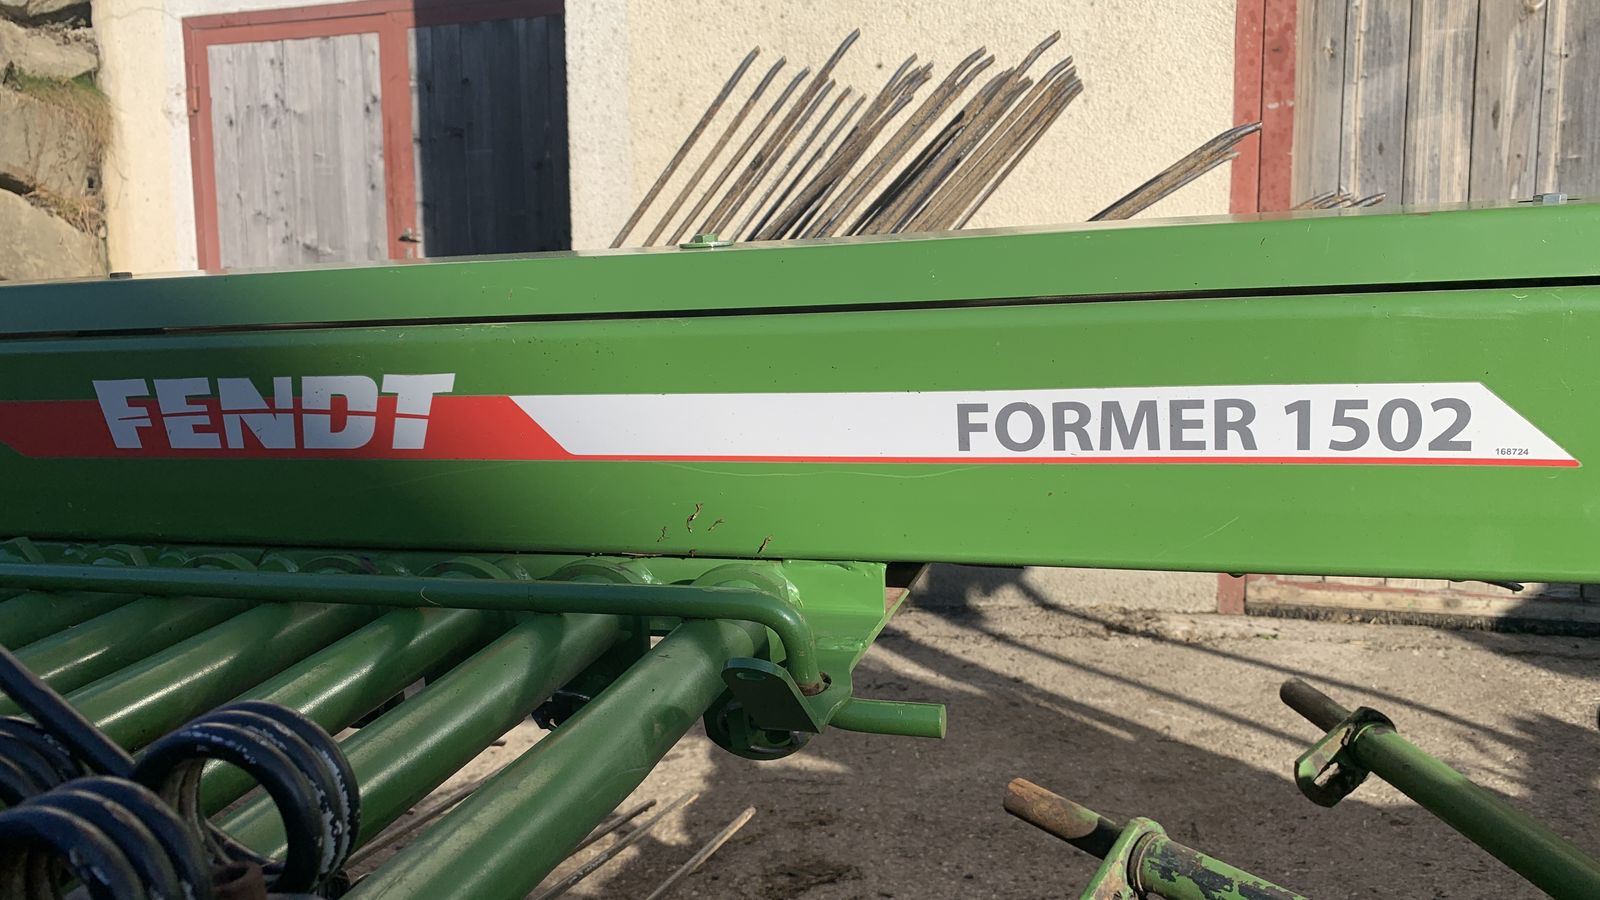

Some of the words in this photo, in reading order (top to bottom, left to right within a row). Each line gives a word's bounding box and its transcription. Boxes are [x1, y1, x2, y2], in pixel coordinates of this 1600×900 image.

[92, 373, 456, 449] FENDT
[956, 399, 1257, 452] FORMER
[1284, 397, 1472, 452] 1502
[1495, 447, 1529, 456] 168724
